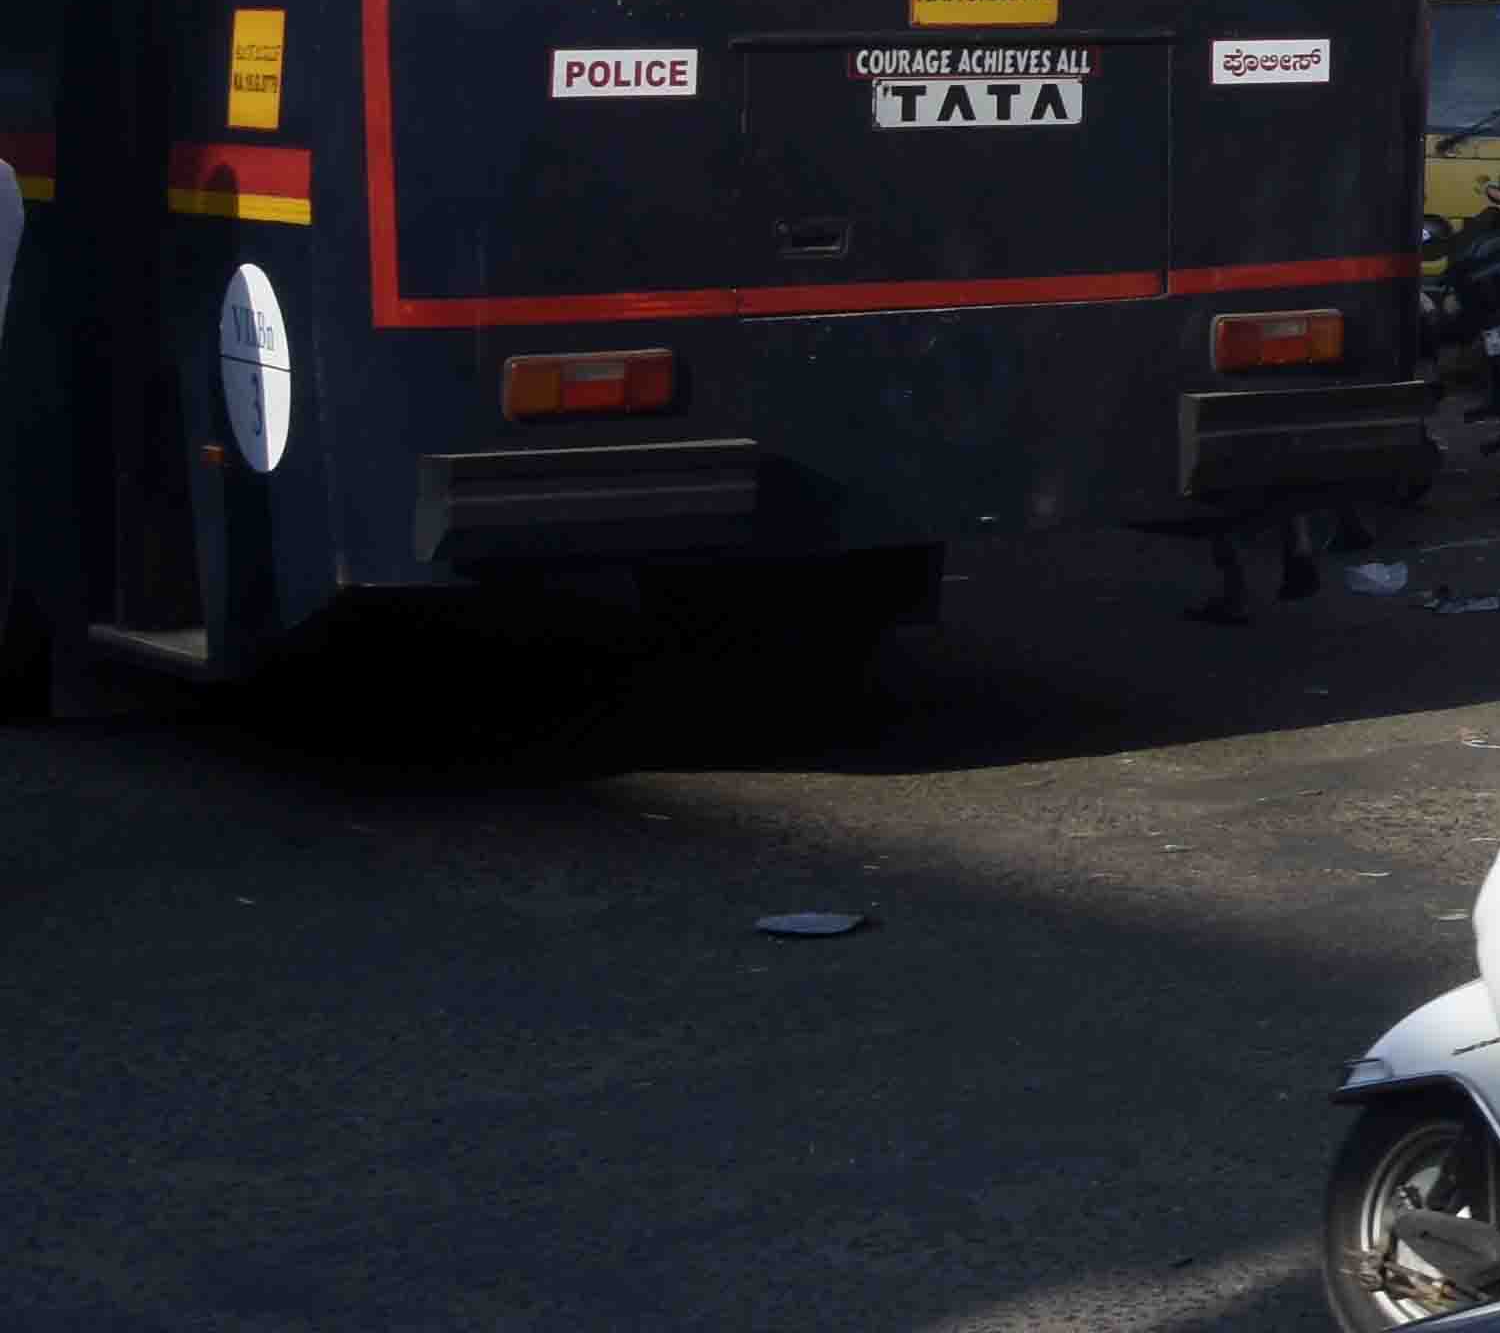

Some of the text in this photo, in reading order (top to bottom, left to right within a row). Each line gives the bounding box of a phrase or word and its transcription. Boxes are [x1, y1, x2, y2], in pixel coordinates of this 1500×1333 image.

[565, 60, 689, 88] POLICE
[856, 49, 1091, 74] COURAGE ACHIEVES ALL
[1223, 48, 1322, 77] ಪೊಲೀಸ್
[890, 83, 1069, 122] TATA
